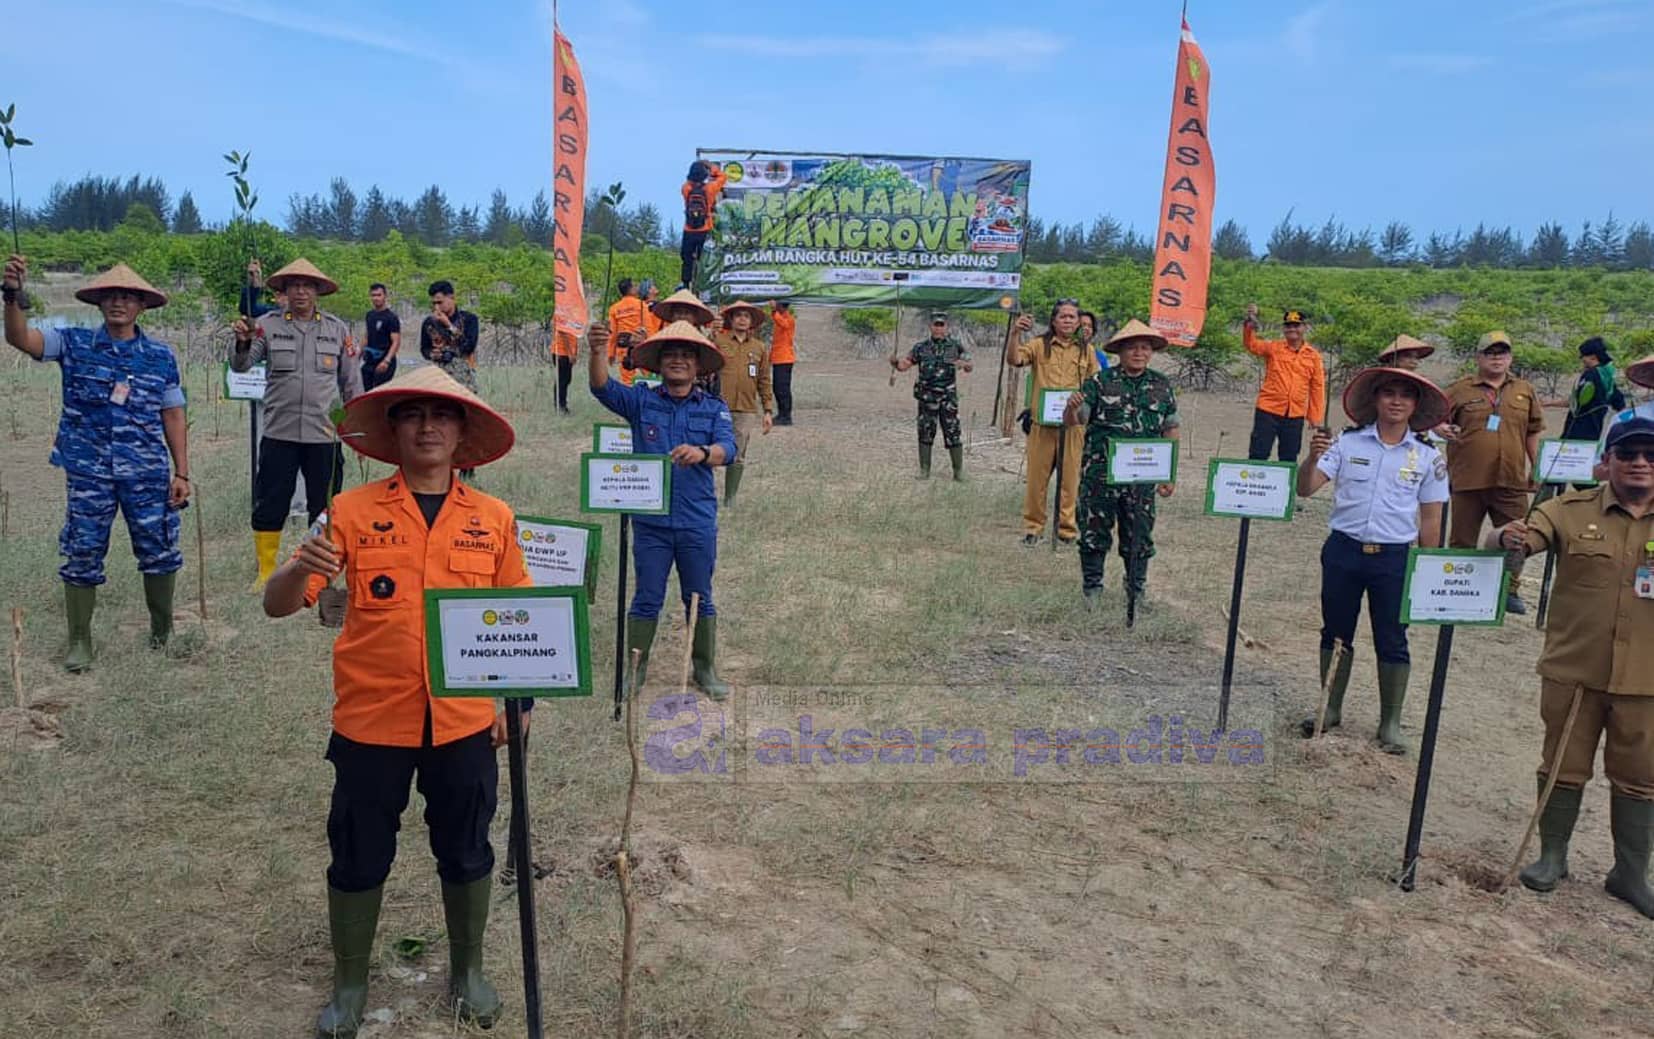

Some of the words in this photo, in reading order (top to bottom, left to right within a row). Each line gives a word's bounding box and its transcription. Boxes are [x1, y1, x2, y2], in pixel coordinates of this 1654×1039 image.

[553, 74, 578, 293] BASARNAS
[743, 186, 978, 220] PENANAMAN
[759, 216, 968, 250] MANGROVE
[723, 250, 773, 266] DALAM
[775, 249, 836, 264] RANGKA
[840, 252, 868, 265] HUT
[873, 252, 916, 266] KE-54
[920, 254, 999, 268] BASARNAS
[359, 535, 408, 545] MIKEL
[454, 539, 497, 552] BASARNAS
[476, 632, 539, 643] KAKANSAR
[460, 647, 557, 659] PANGKALPINANG
